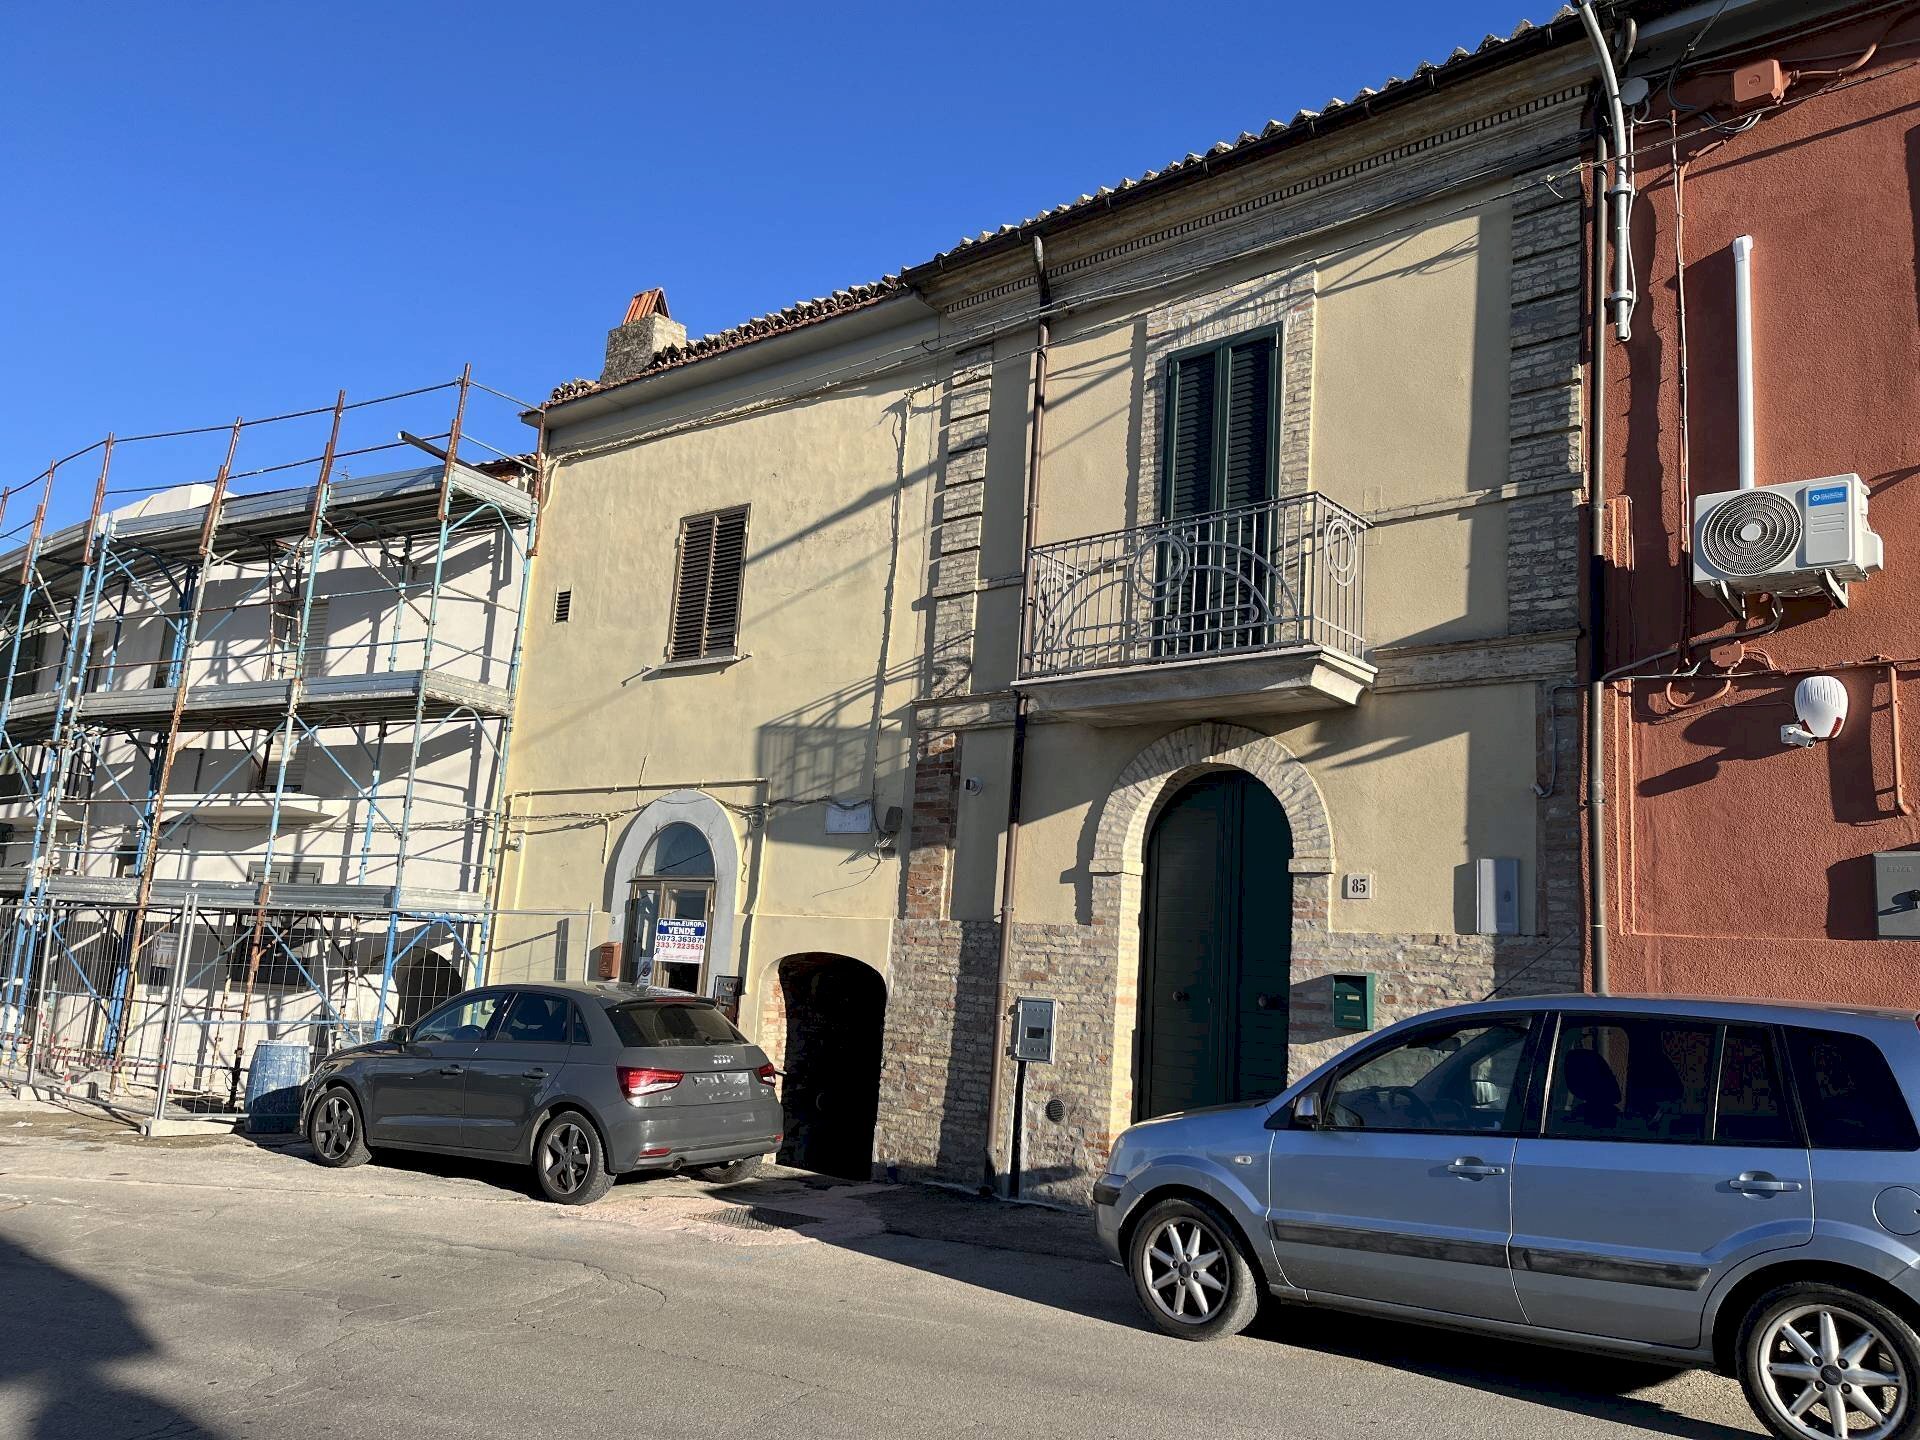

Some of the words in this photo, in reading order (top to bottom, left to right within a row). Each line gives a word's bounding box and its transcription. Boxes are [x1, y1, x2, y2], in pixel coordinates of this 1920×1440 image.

[1352, 878, 1367, 893] 85
[668, 926, 696, 936] VENDE
[656, 934, 705, 944] 0873.363871
[656, 941, 704, 951] 333.7223550
